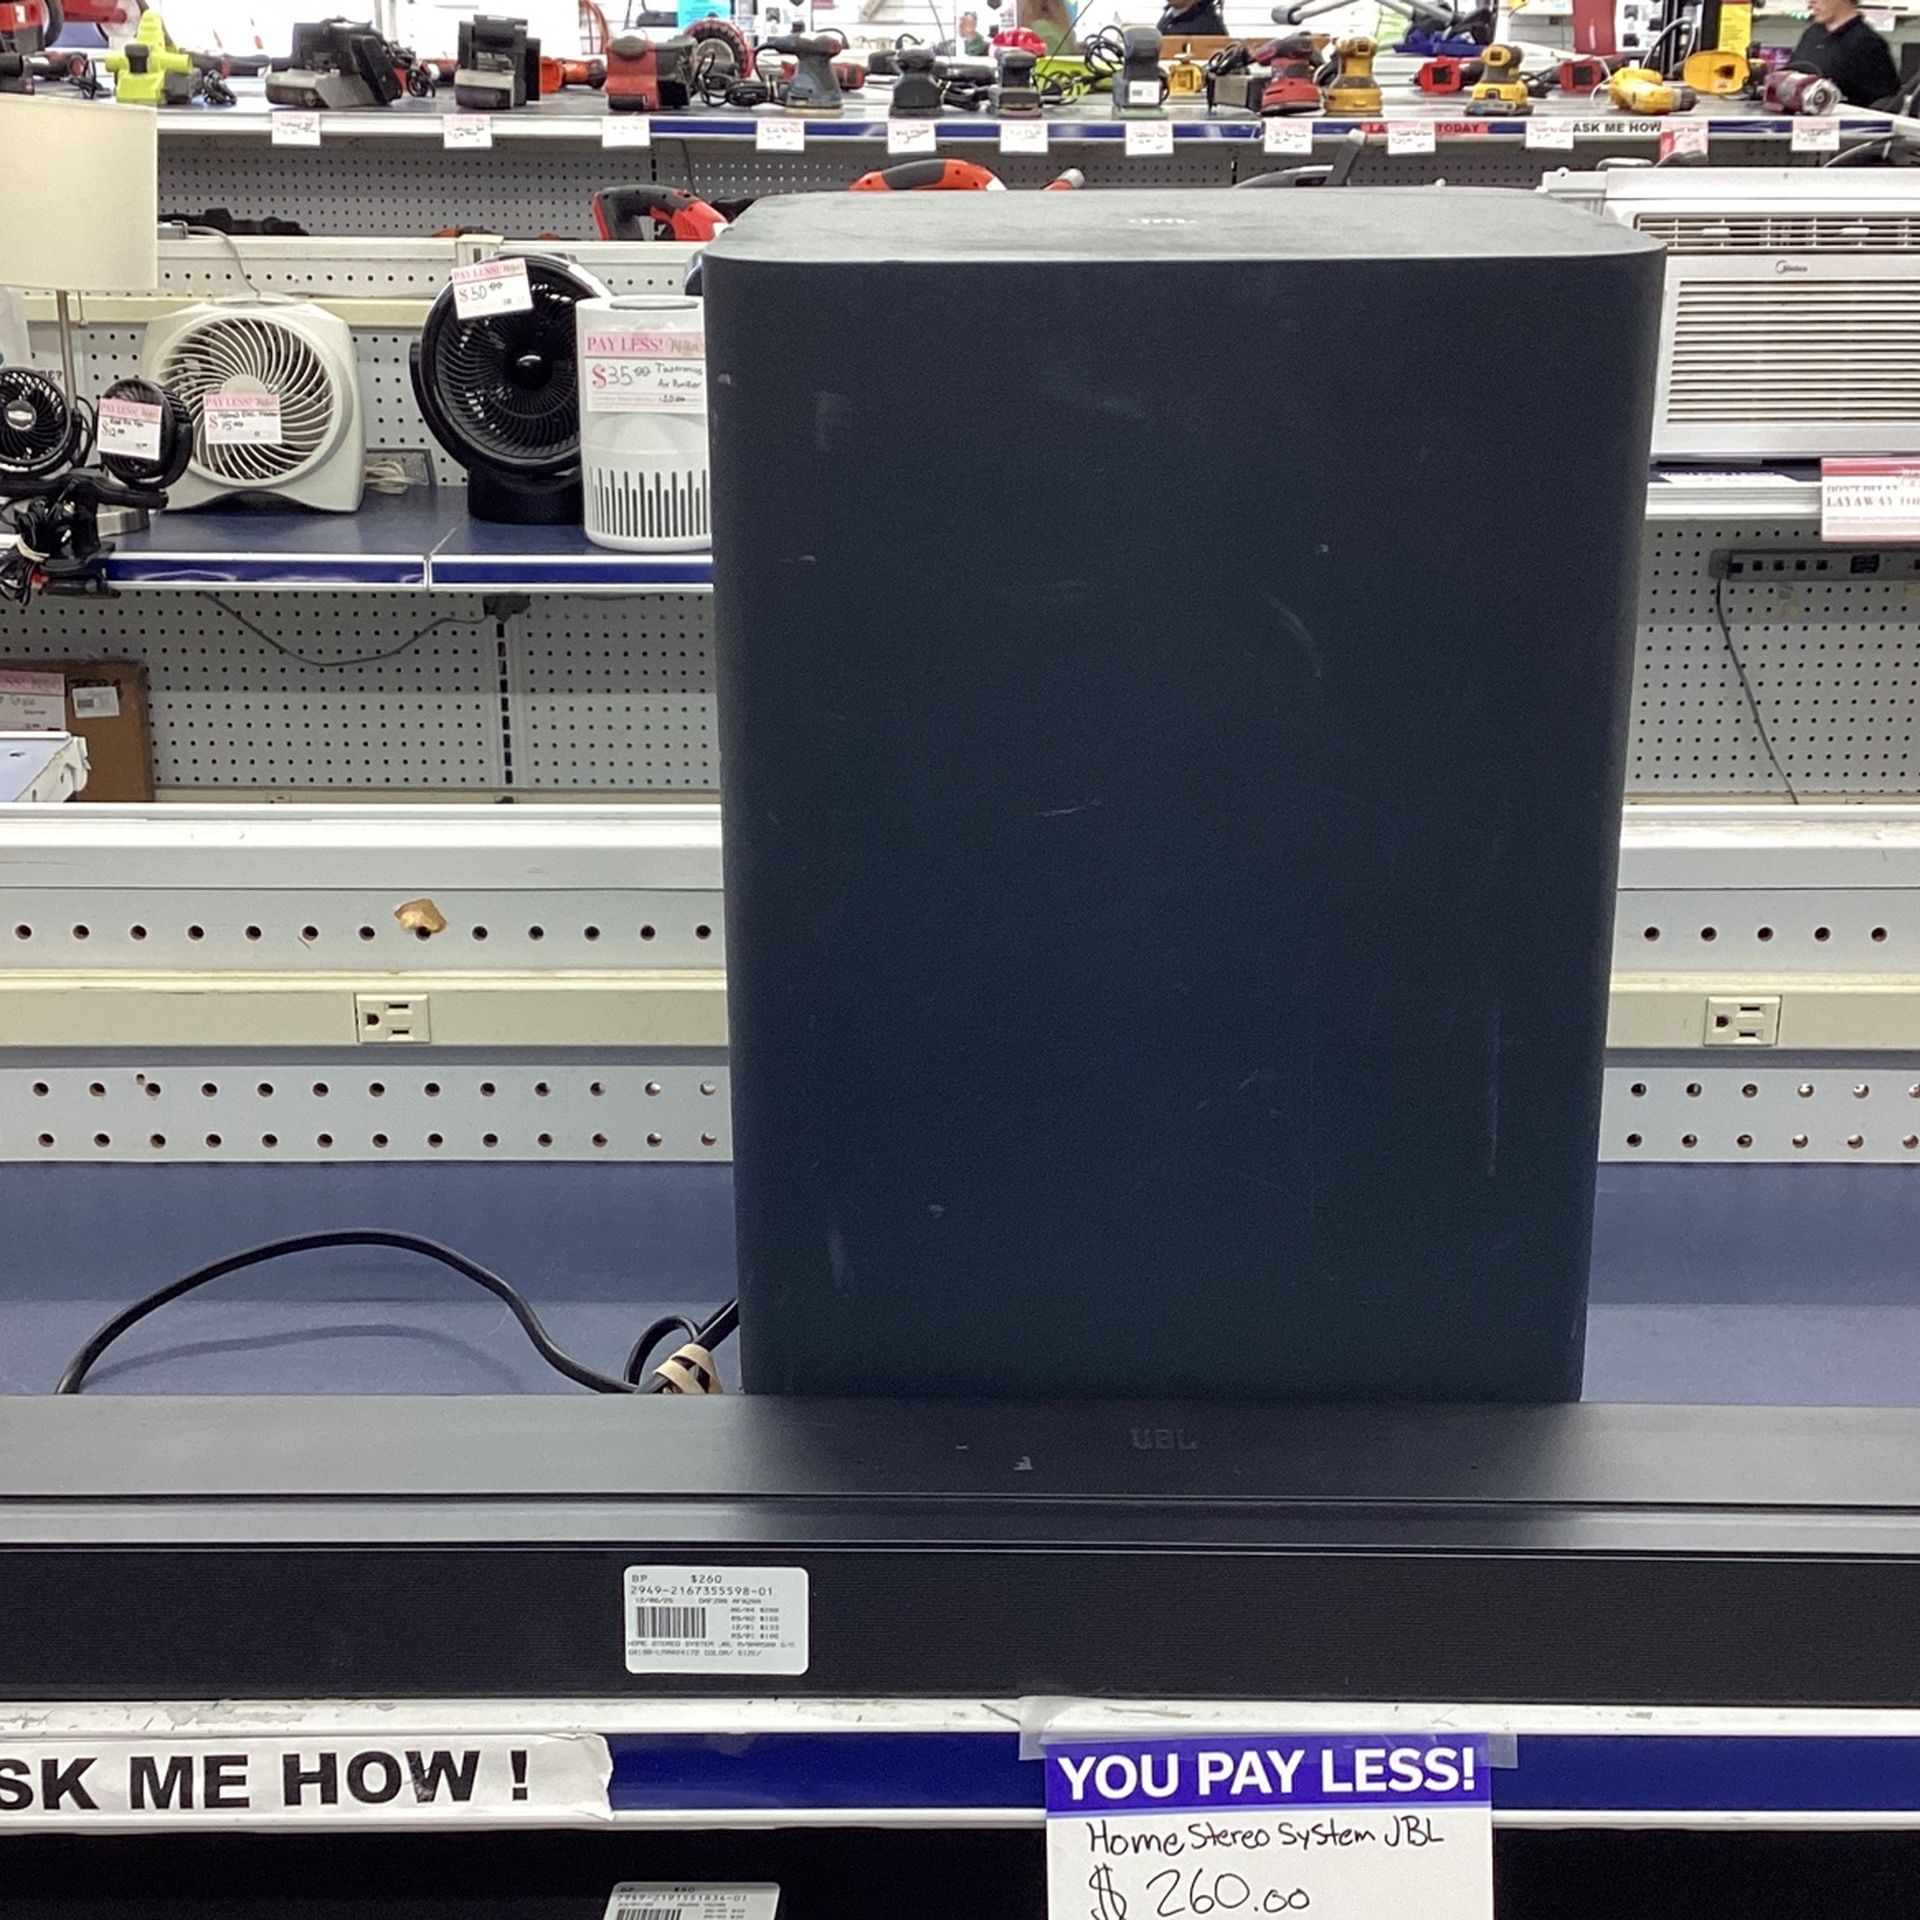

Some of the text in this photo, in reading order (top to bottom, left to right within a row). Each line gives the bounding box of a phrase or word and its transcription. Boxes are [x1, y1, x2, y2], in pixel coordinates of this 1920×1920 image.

[1572, 123, 1600, 134] ASK
[1604, 123, 1625, 134] ME
[1629, 123, 1662, 134] HOW
[587, 336, 614, 351] PAY
[621, 336, 663, 352] LESS!
[690, 1574, 722, 1584] $260
[129, 1754, 250, 1811] ME
[283, 1749, 481, 1807] HOW
[1057, 1746, 1476, 1800] YOU PAY LESS!
[1086, 1815, 1446, 1857] Home Stereo System JBL
[1145, 1867, 1311, 1918] 260.00
